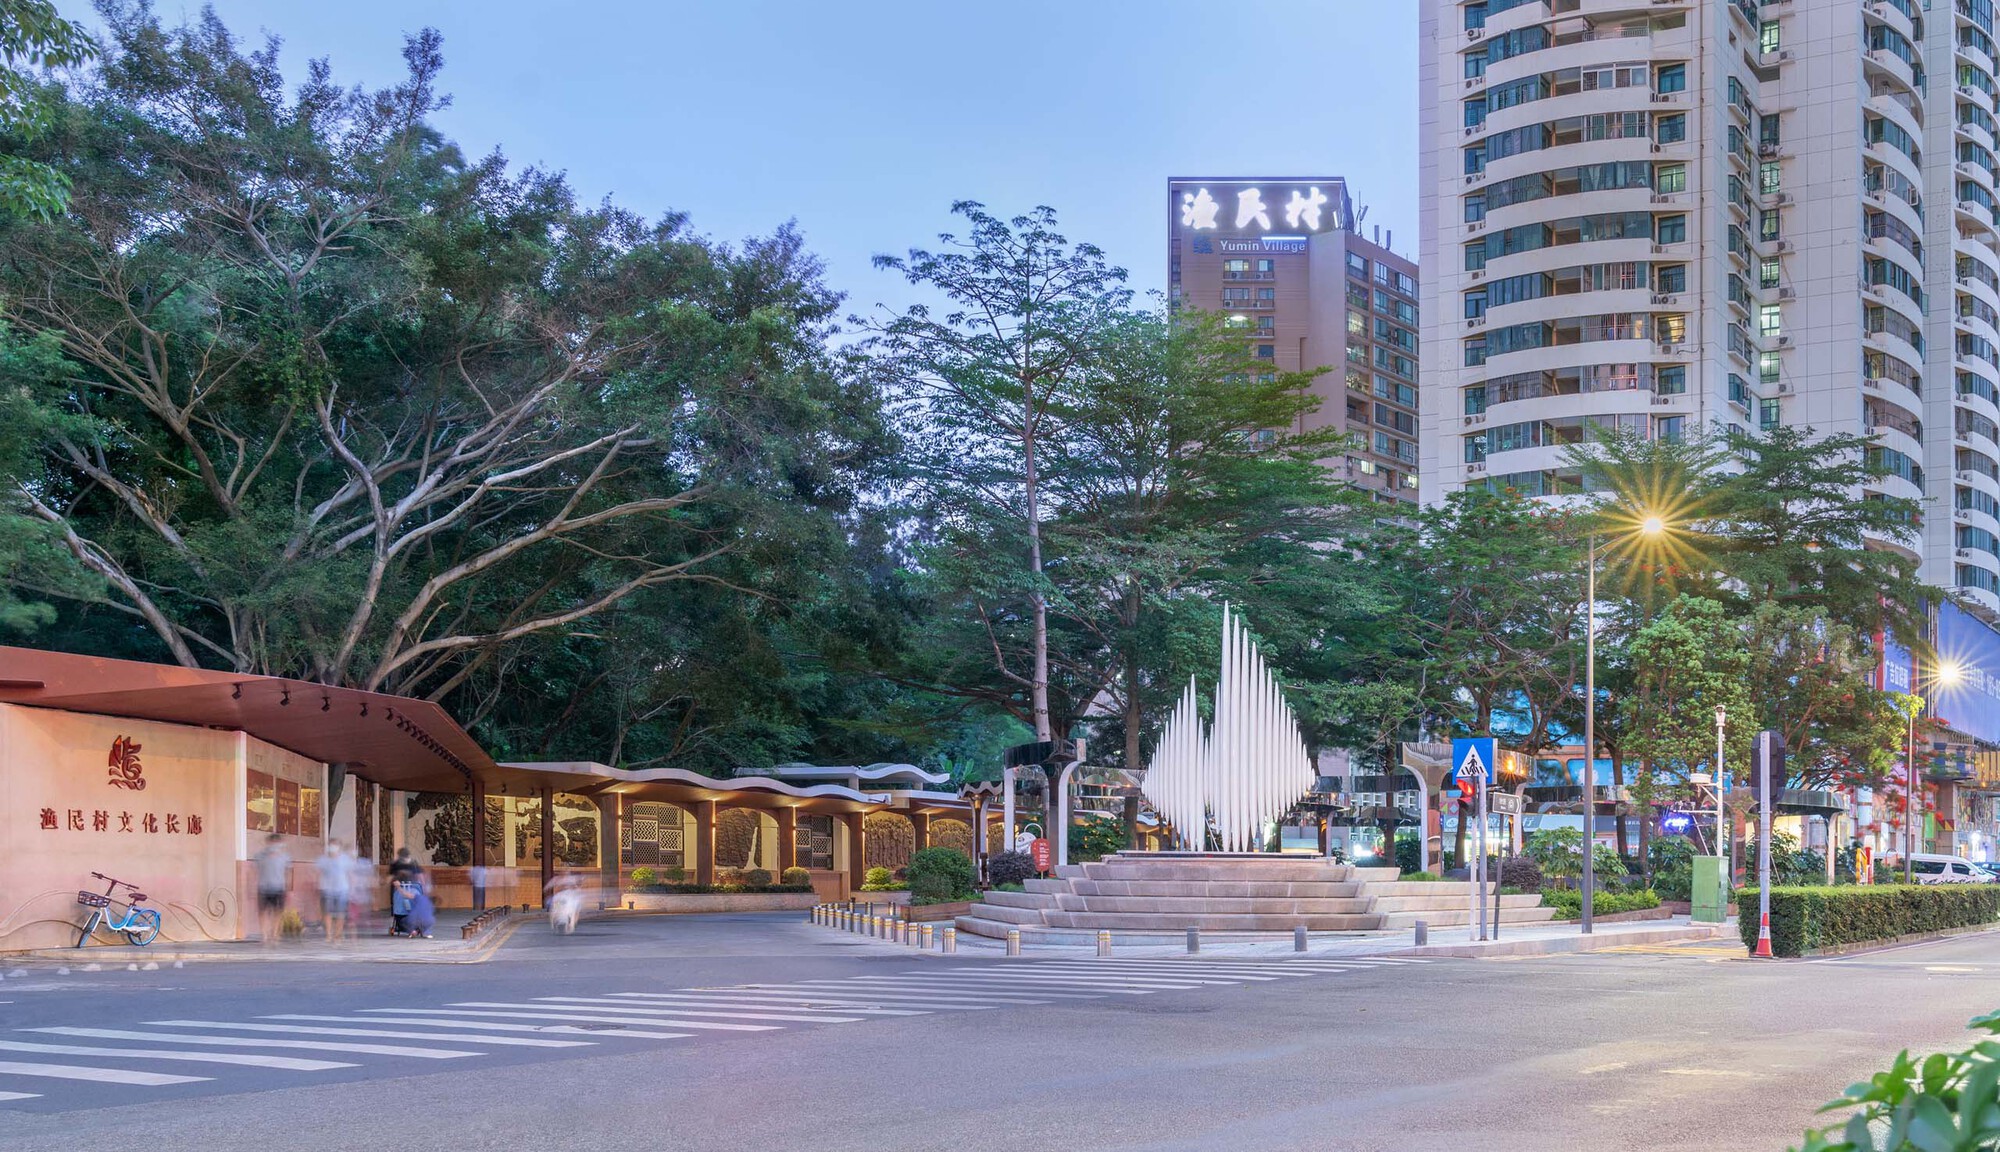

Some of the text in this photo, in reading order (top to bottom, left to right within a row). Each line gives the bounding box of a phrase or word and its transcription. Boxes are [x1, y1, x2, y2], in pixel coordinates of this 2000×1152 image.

[1181, 186, 1328, 231] 渔民村
[1220, 240, 1306, 253] Yumin Village
[39, 807, 203, 836] 渔民村文化长廊
